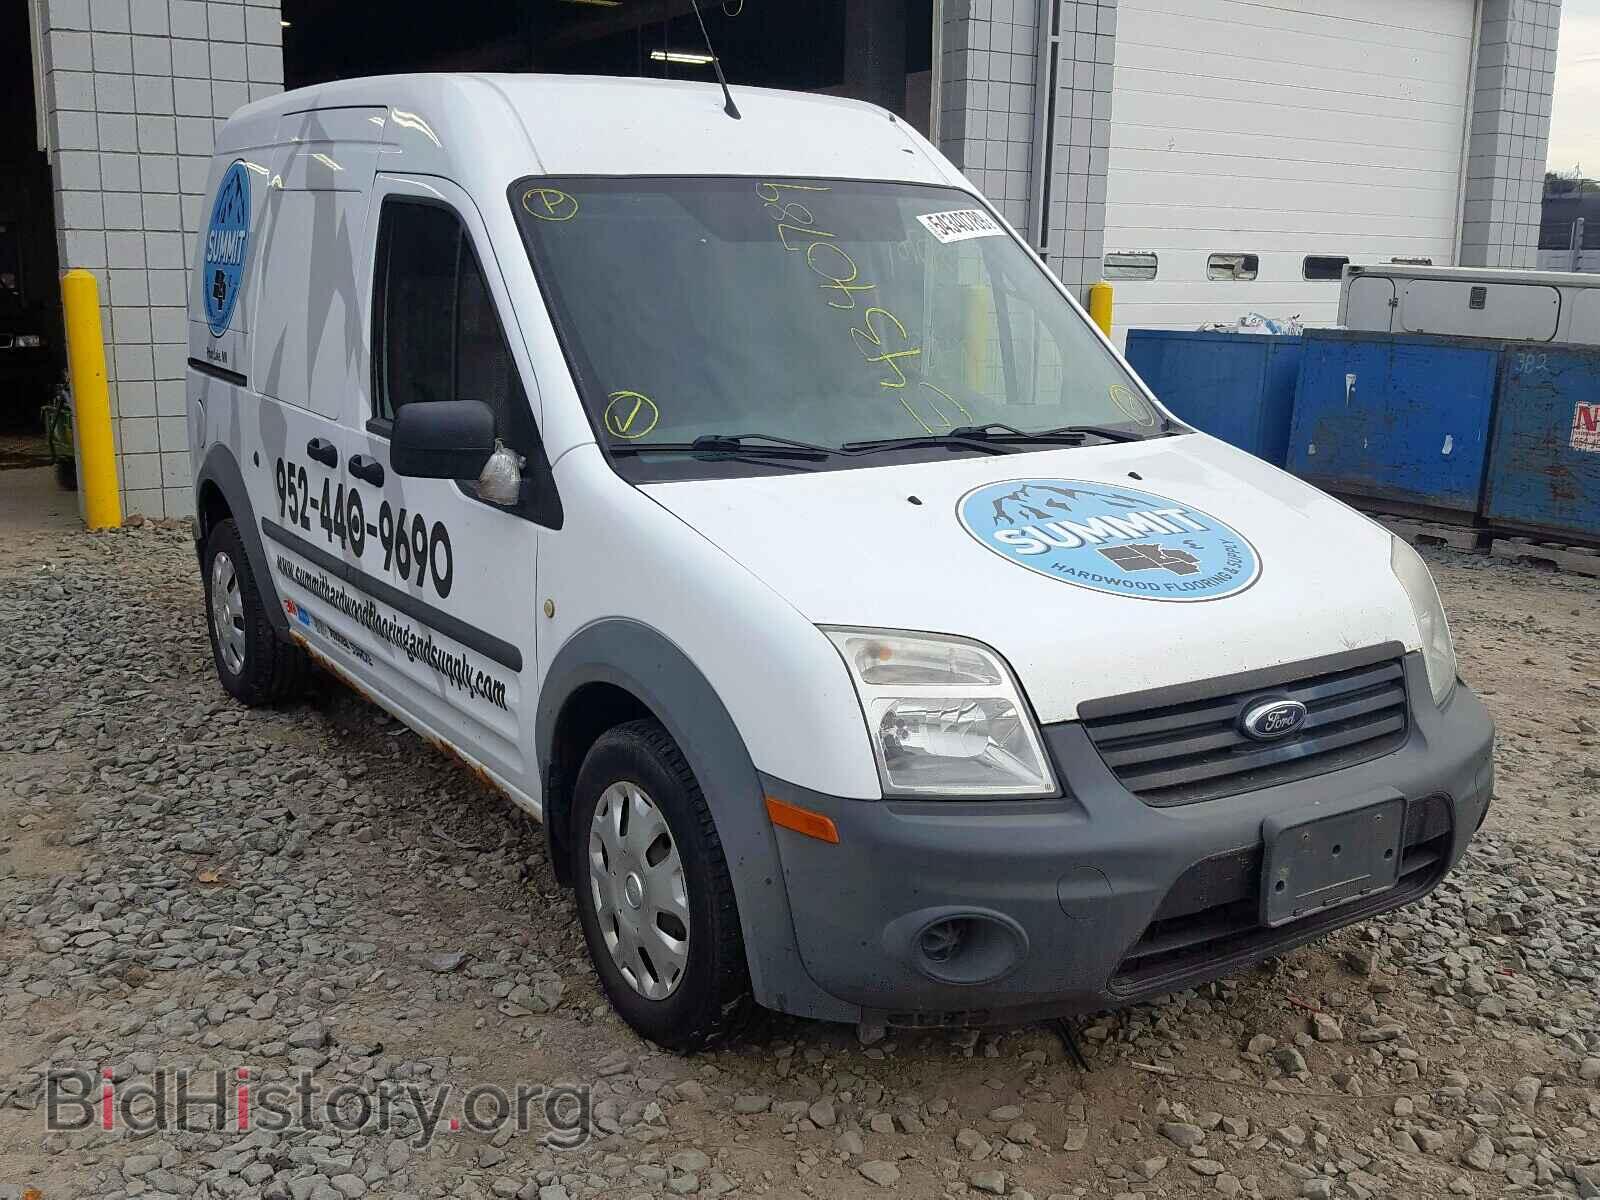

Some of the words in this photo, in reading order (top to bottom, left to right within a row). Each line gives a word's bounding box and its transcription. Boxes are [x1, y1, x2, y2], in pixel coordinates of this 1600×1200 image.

[207, 230, 245, 266] SUMMIT
[277, 456, 453, 600] 952-440-9690
[993, 508, 1210, 556] SUMMIT
[1051, 562, 1162, 593] HARDWOOD
[1163, 571, 1233, 592] FLOORING
[1219, 538, 1243, 569] SUPPLY
[276, 554, 507, 711] www.summithardwoodflooringandsupply.com
[1264, 708, 1296, 733] Ford
